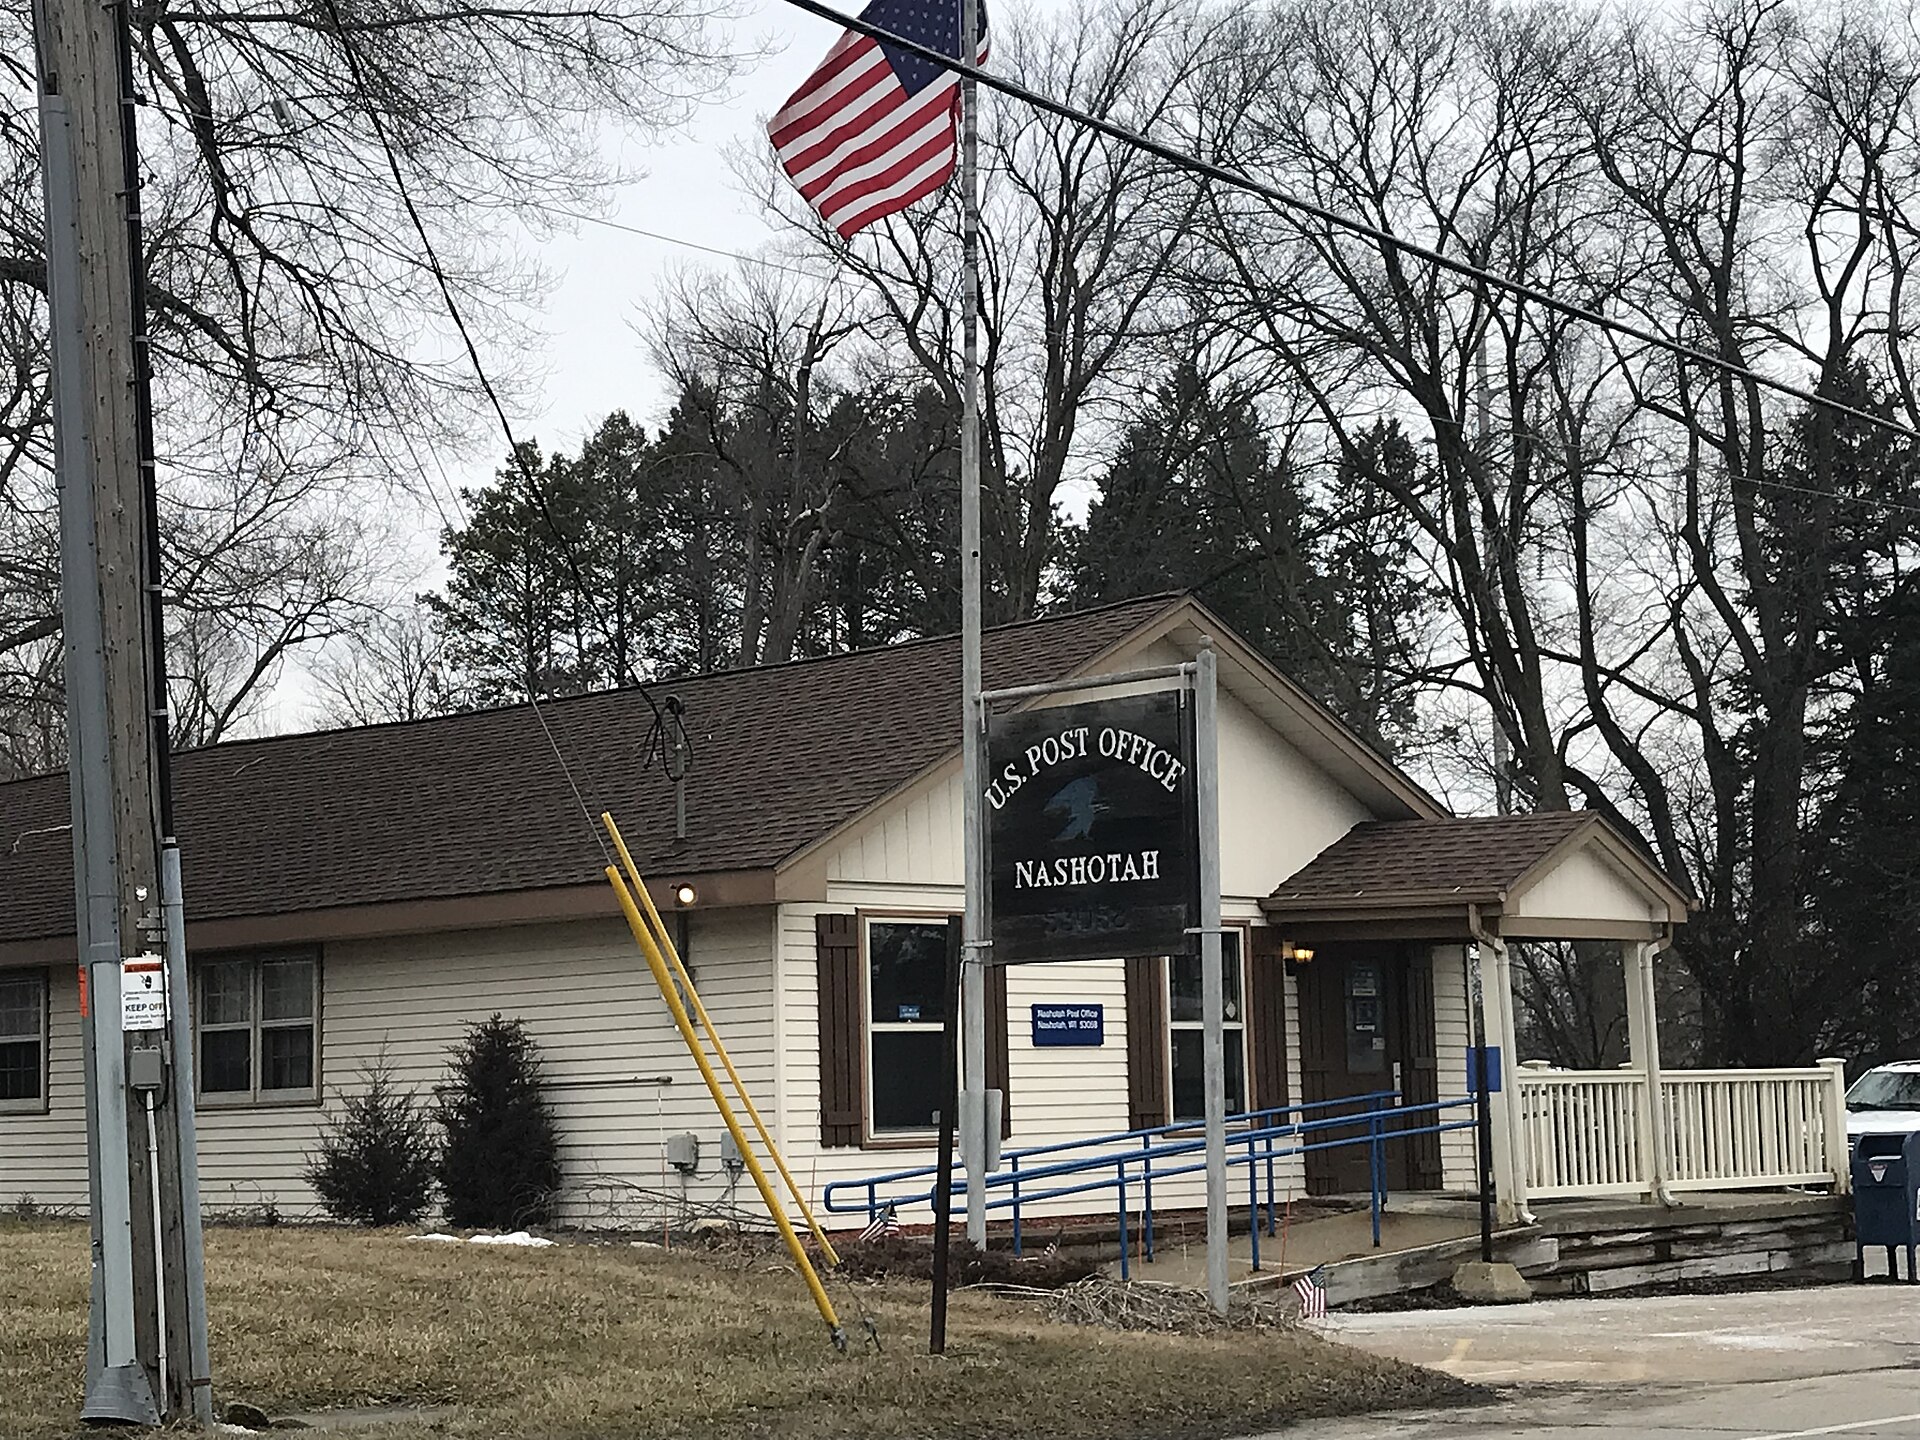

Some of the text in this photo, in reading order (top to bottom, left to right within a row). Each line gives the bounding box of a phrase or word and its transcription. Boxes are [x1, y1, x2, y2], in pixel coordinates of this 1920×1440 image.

[984, 727, 1186, 810] U.S. POST OFFICE
[1014, 850, 1160, 889] NASHOTAH
[125, 1002, 164, 1012] KEEP OFF
[1037, 1008, 1098, 1018] Nashotah Post Office
